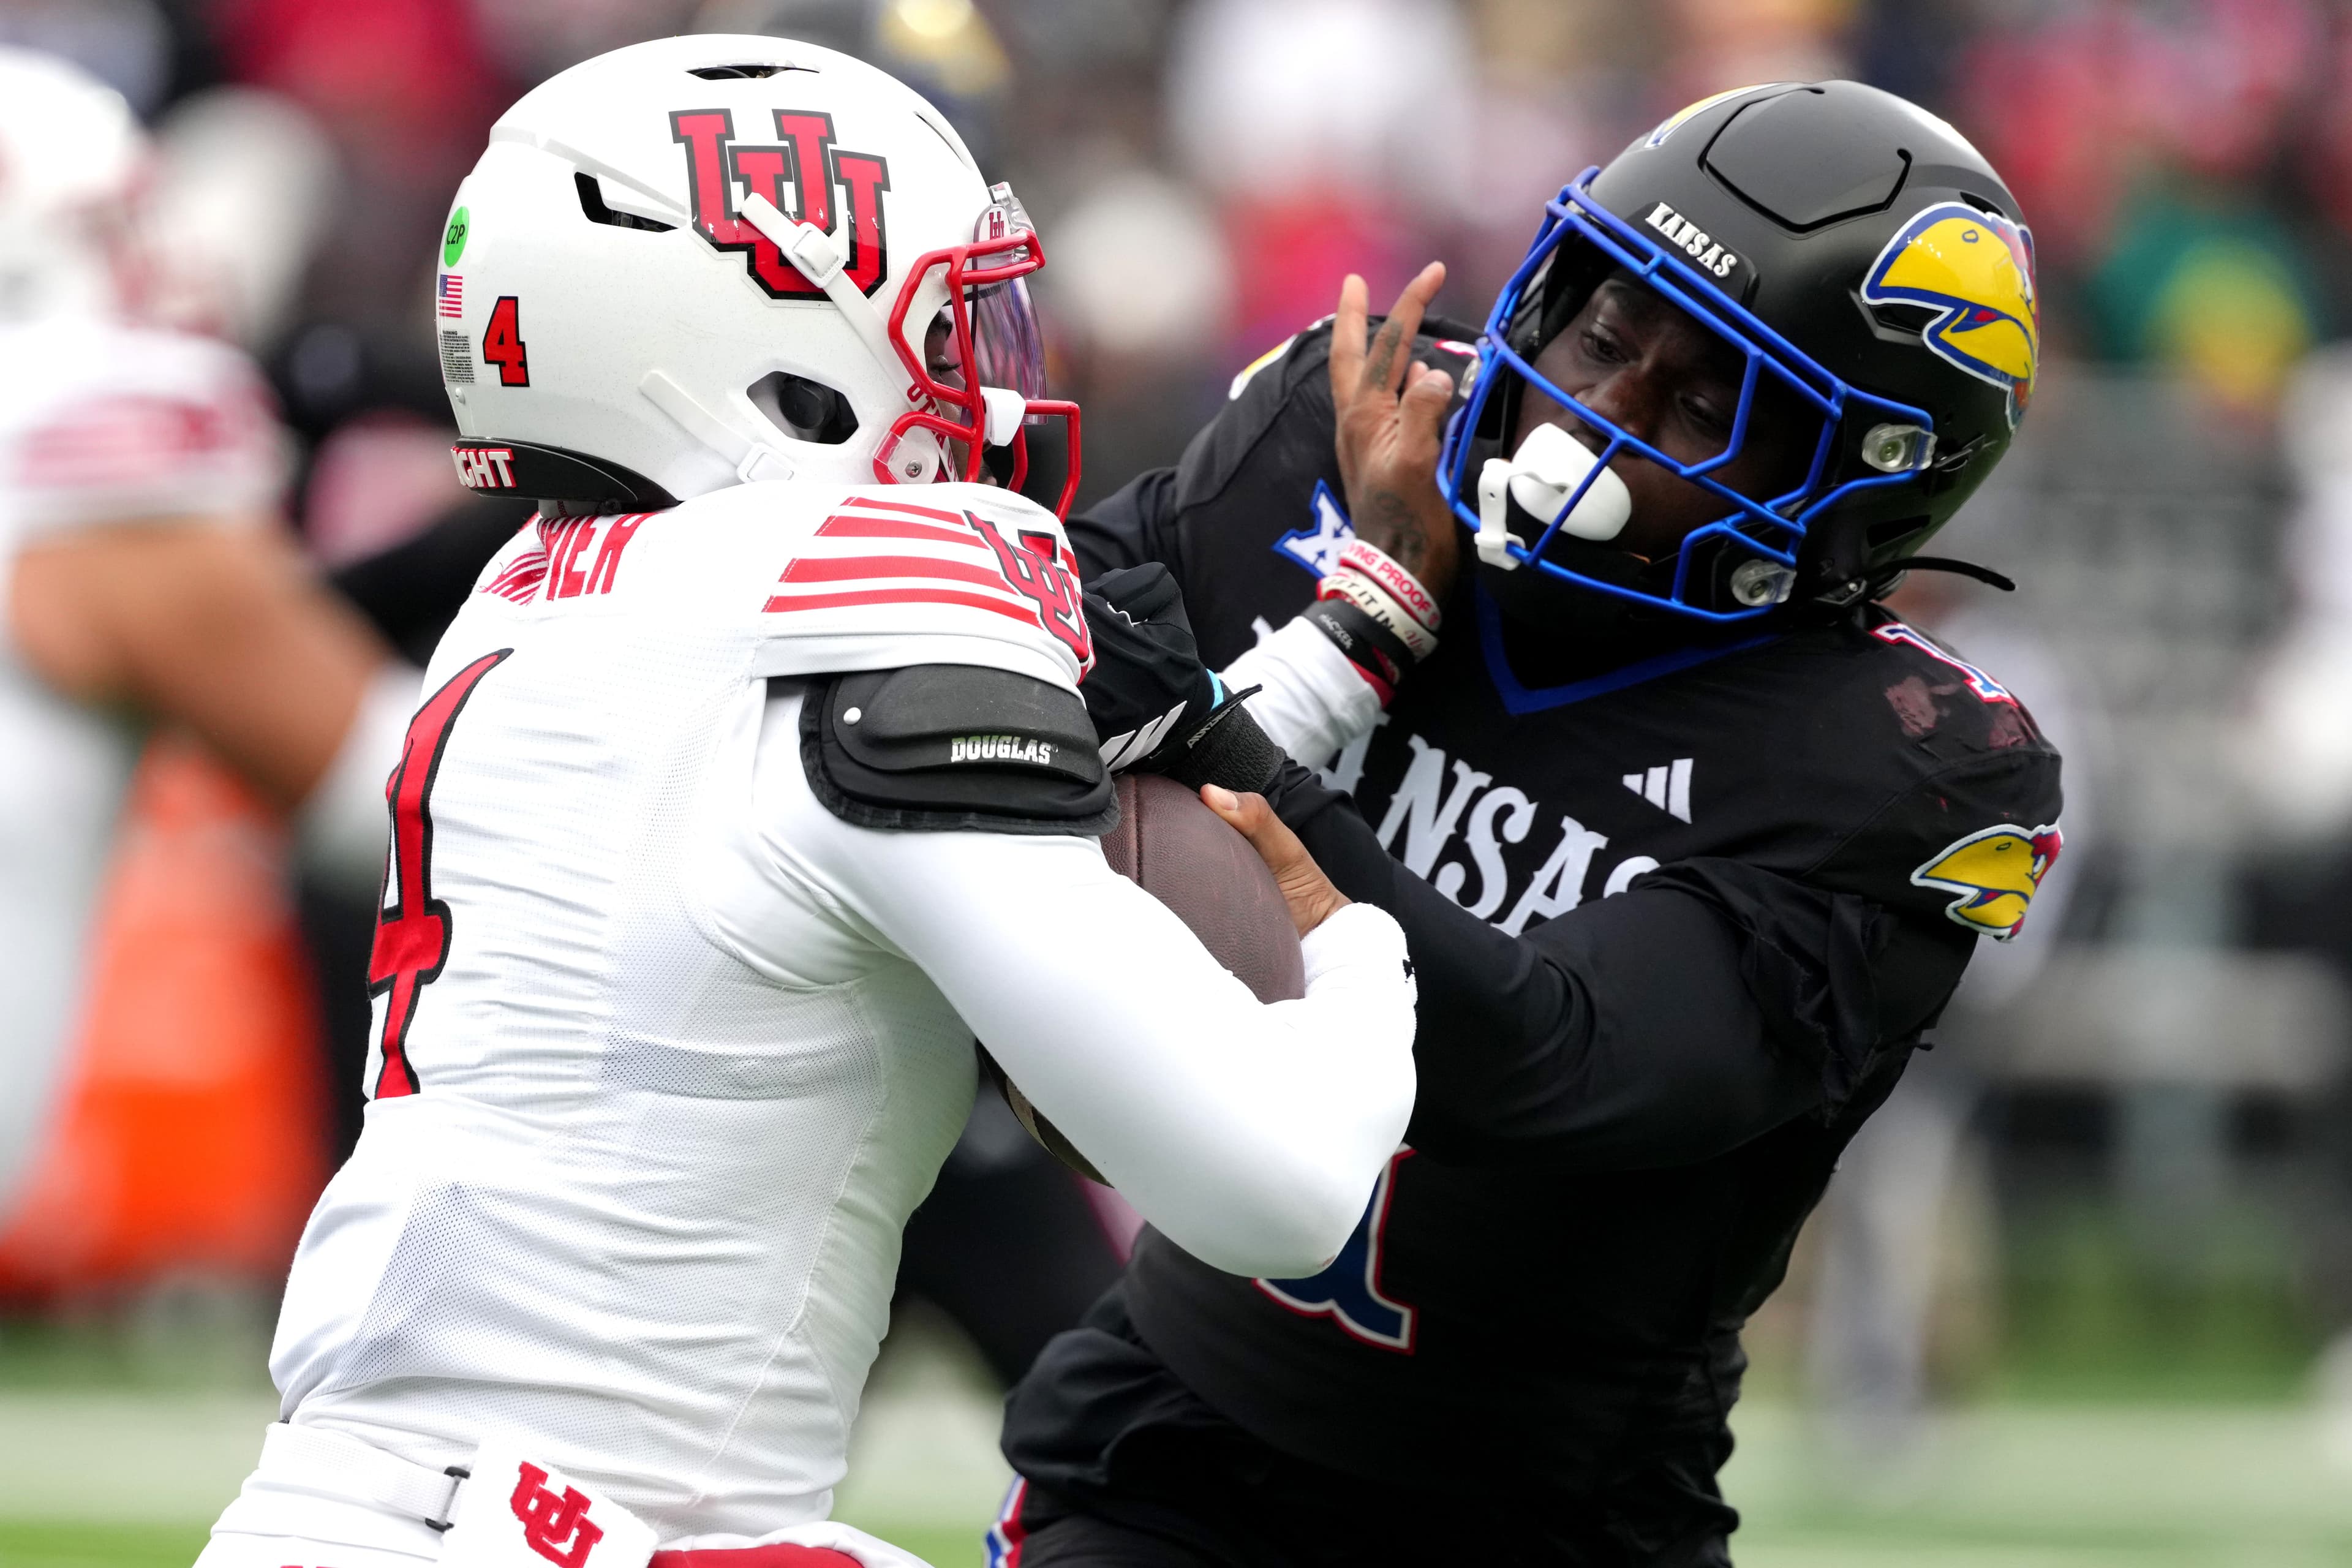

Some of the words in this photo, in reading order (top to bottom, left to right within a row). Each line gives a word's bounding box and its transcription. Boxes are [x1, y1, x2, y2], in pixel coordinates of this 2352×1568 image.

[447, 224, 465, 244] C2P
[1645, 202, 1738, 277] KANSAS
[482, 296, 530, 387] 4
[1358, 591, 1378, 606] IT
[1374, 609, 1395, 630] IN
[1378, 562, 1431, 613] PROOF
[951, 735, 1051, 764] DOUGLAS
[366, 647, 514, 1099] 4
